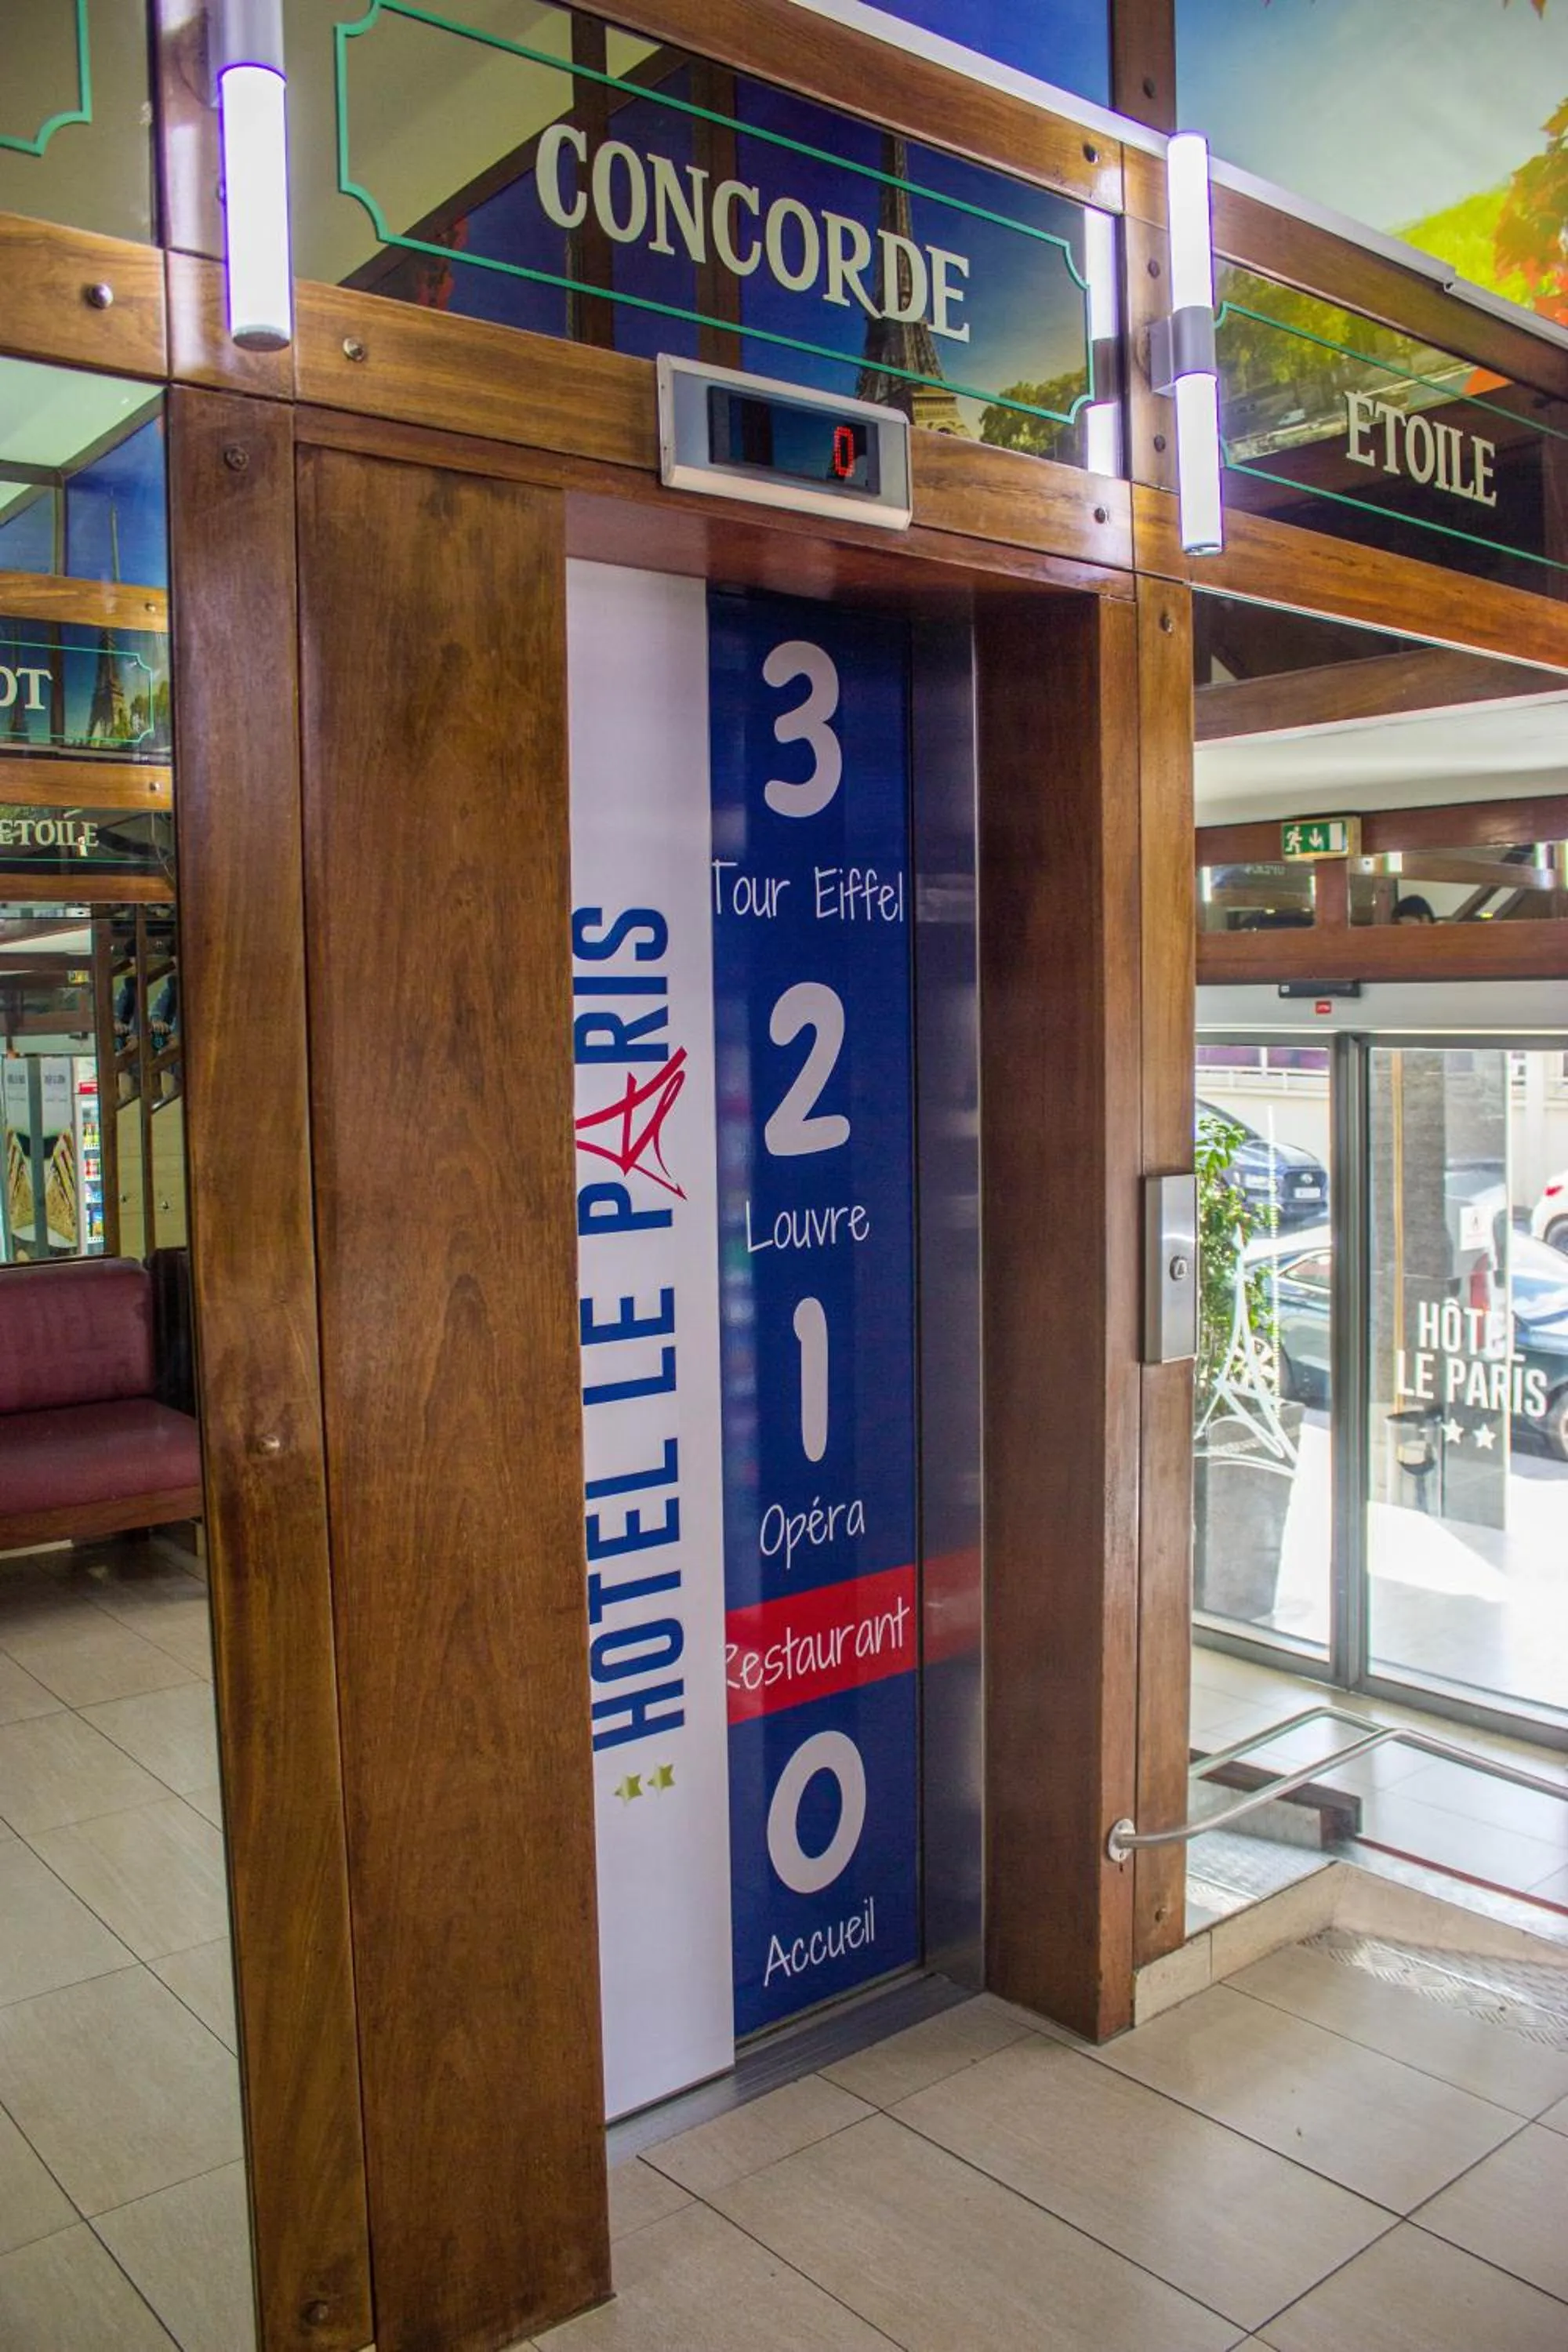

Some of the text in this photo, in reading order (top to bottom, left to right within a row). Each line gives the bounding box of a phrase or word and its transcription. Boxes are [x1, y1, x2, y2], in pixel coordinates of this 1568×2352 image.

[535, 124, 971, 343] CONCORDE
[833, 426, 855, 477] 0
[763, 641, 842, 818] 3
[711, 858, 904, 922] Tour Eiffel
[764, 982, 851, 1156] 2
[745, 1200, 870, 1254] Louvre
[572, 906, 688, 1752] HOTEL LE PARIS
[793, 1297, 829, 1462] 1
[1396, 1348, 1548, 1417] LE PARIS
[759, 1496, 866, 1569] Opéra
[767, 1730, 866, 1893] 0
[763, 1896, 876, 1987] Accueil
